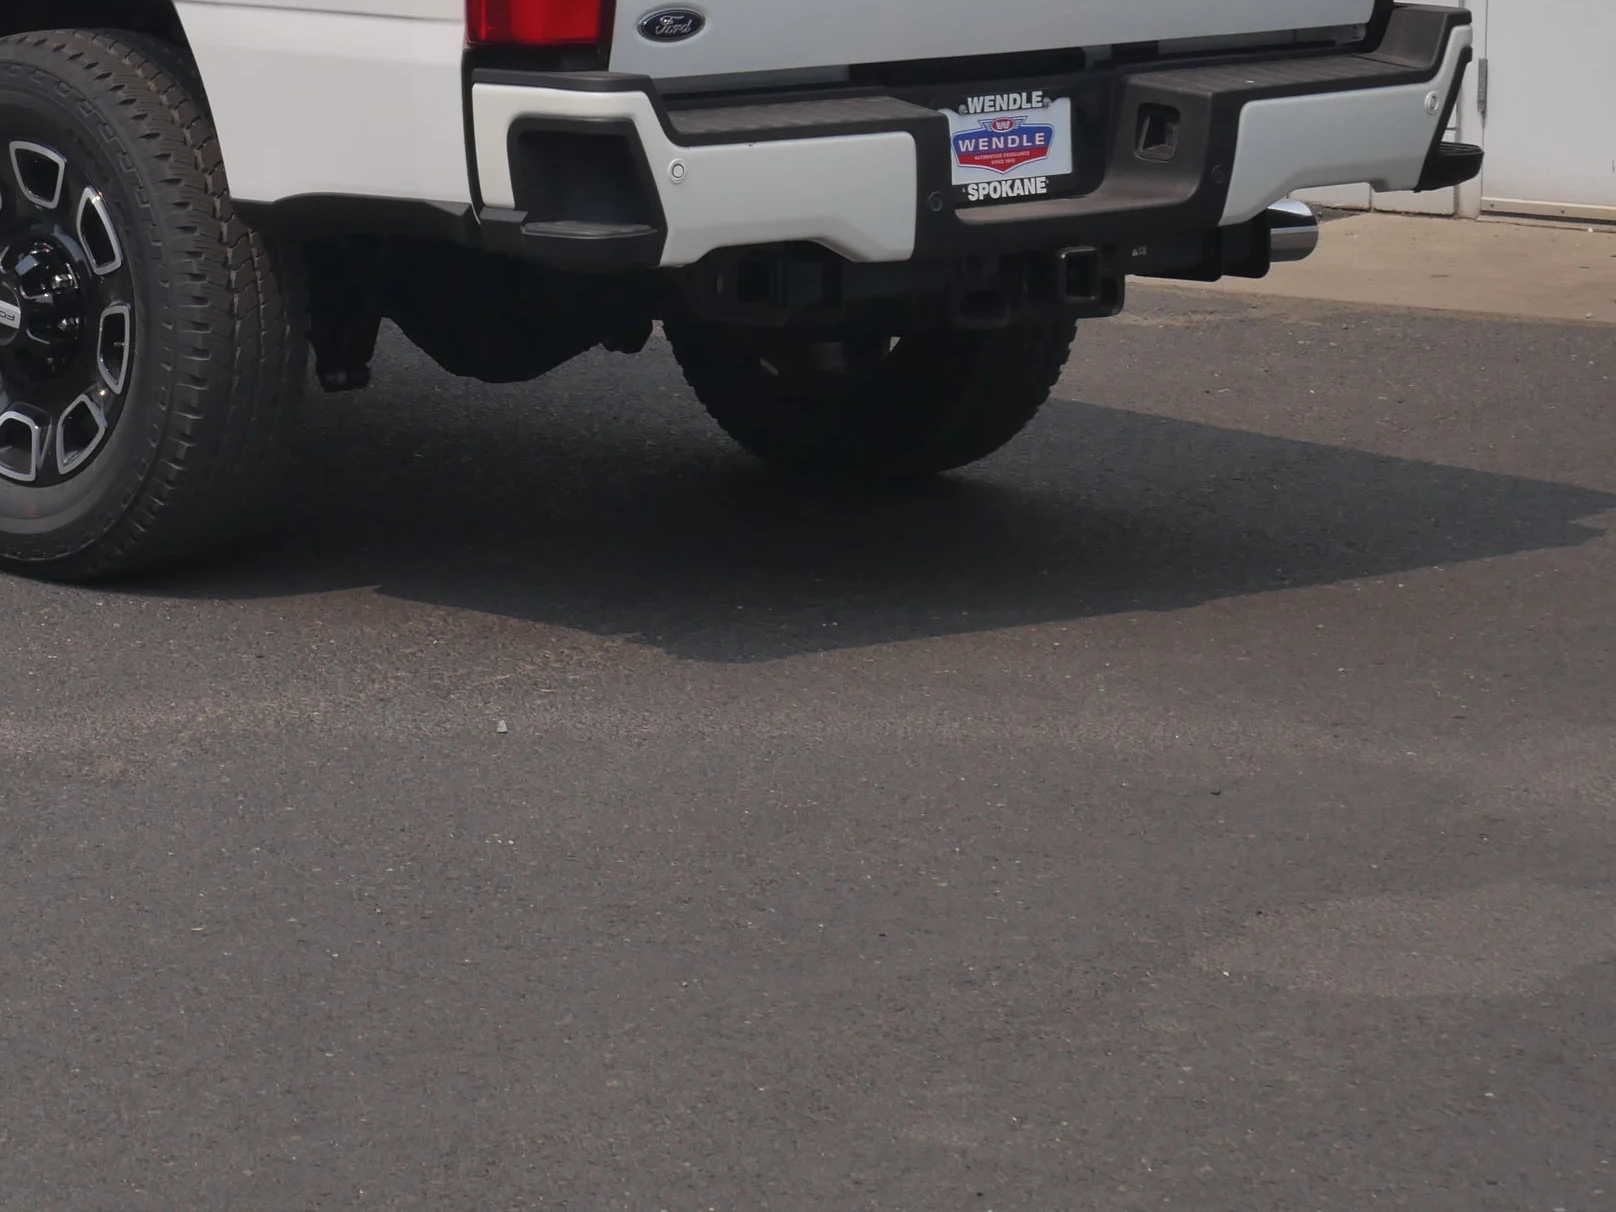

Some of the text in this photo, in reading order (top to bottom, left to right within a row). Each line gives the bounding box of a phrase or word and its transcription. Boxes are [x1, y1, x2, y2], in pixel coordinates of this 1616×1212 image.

[655, 15, 693, 35] Ford
[967, 91, 1044, 114] WENDLE
[958, 133, 1046, 152] WENDLE
[967, 176, 1048, 201] SPOKANE
